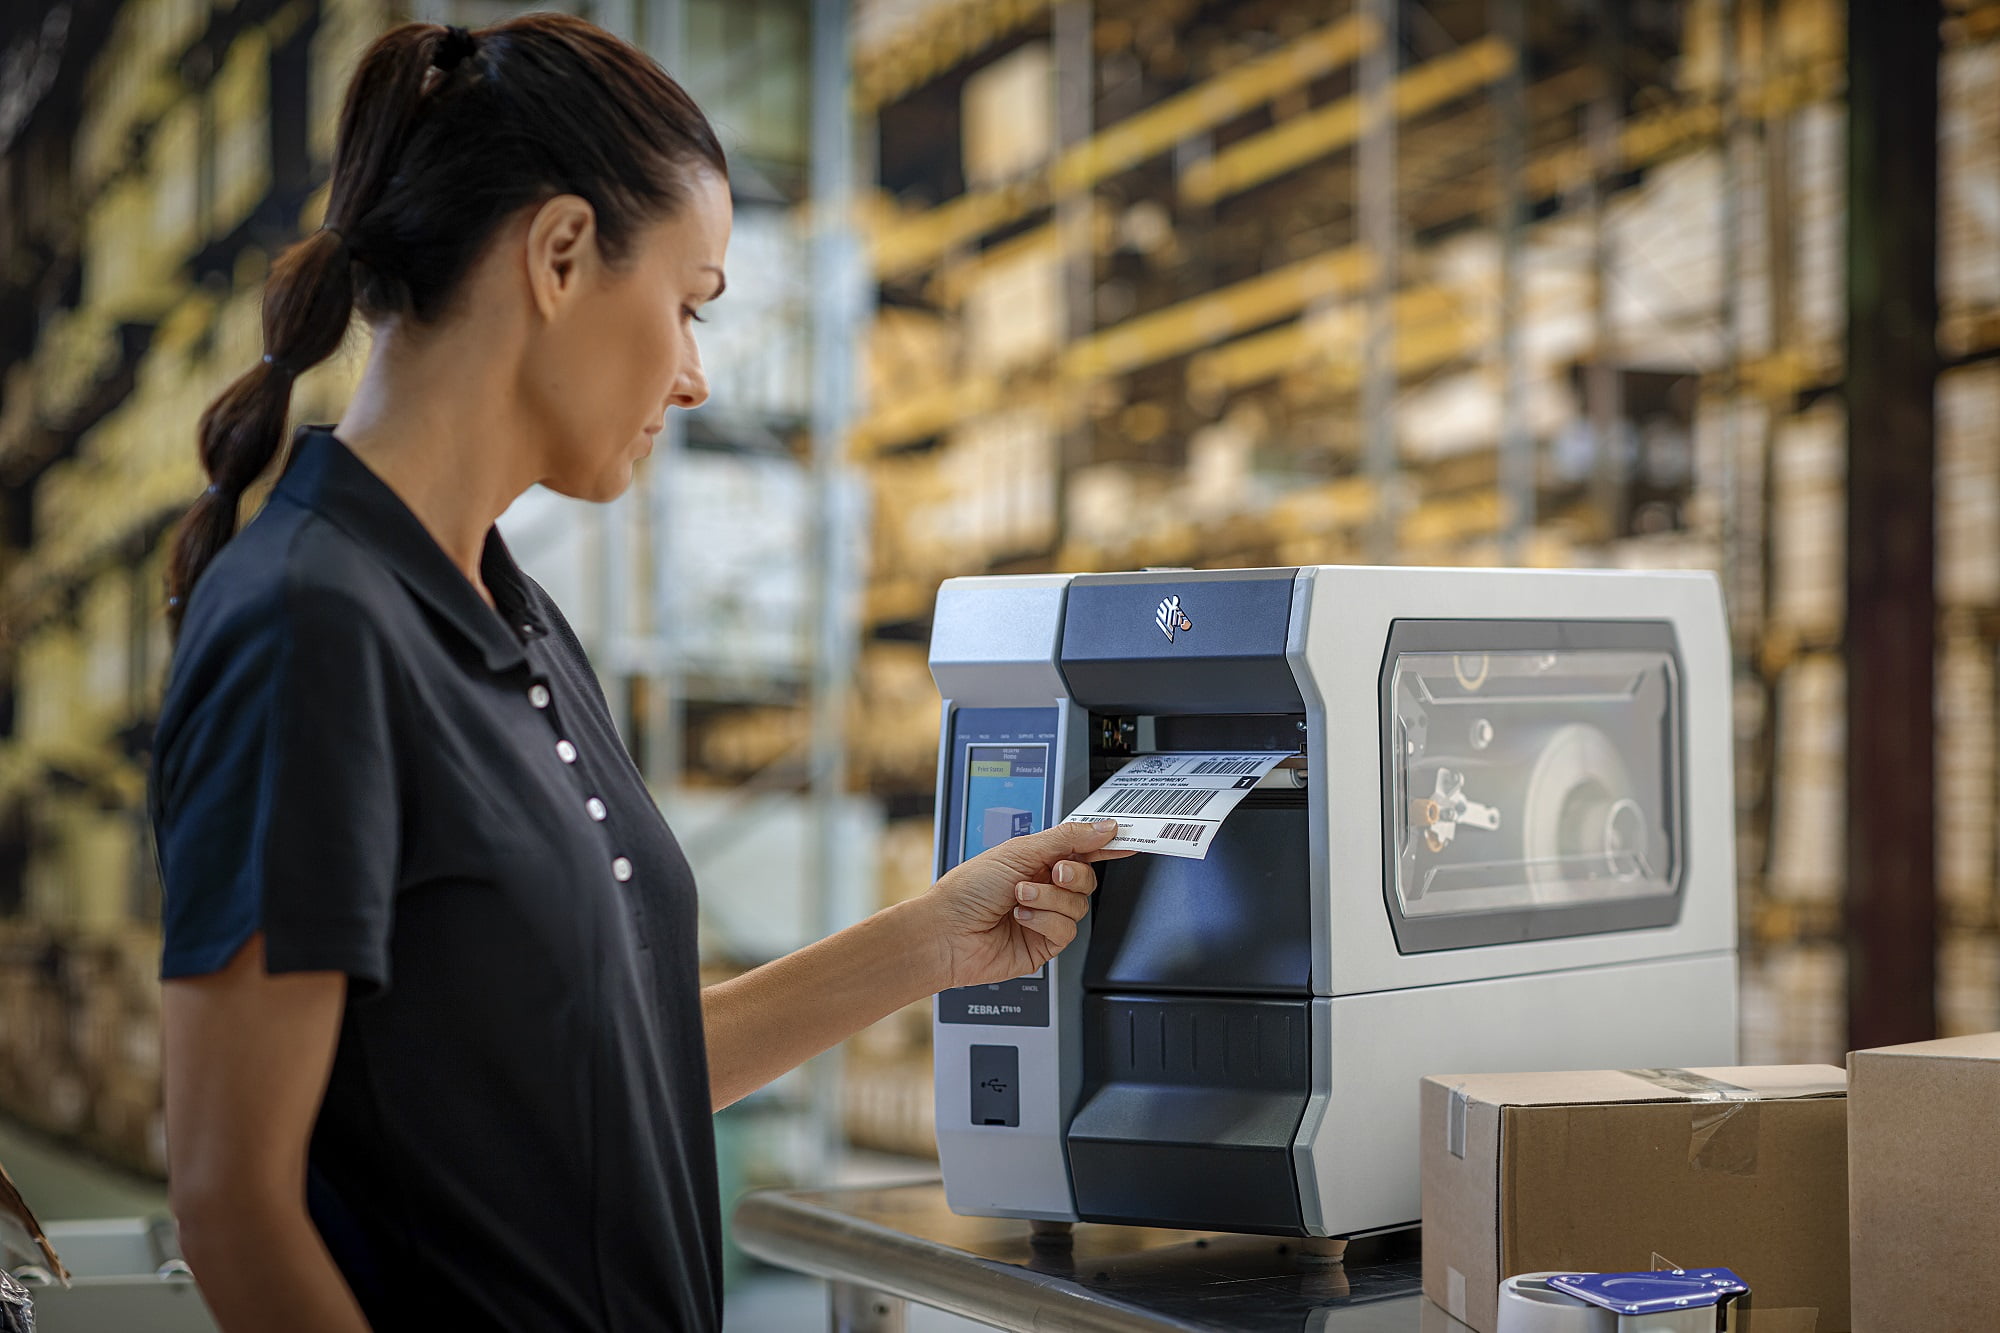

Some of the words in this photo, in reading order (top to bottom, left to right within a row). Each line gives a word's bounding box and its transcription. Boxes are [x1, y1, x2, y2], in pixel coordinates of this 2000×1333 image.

[1240, 778, 1251, 787] 1
[968, 1004, 1000, 1015] ZEBRA
[1001, 1005, 1021, 1013] ZT610
